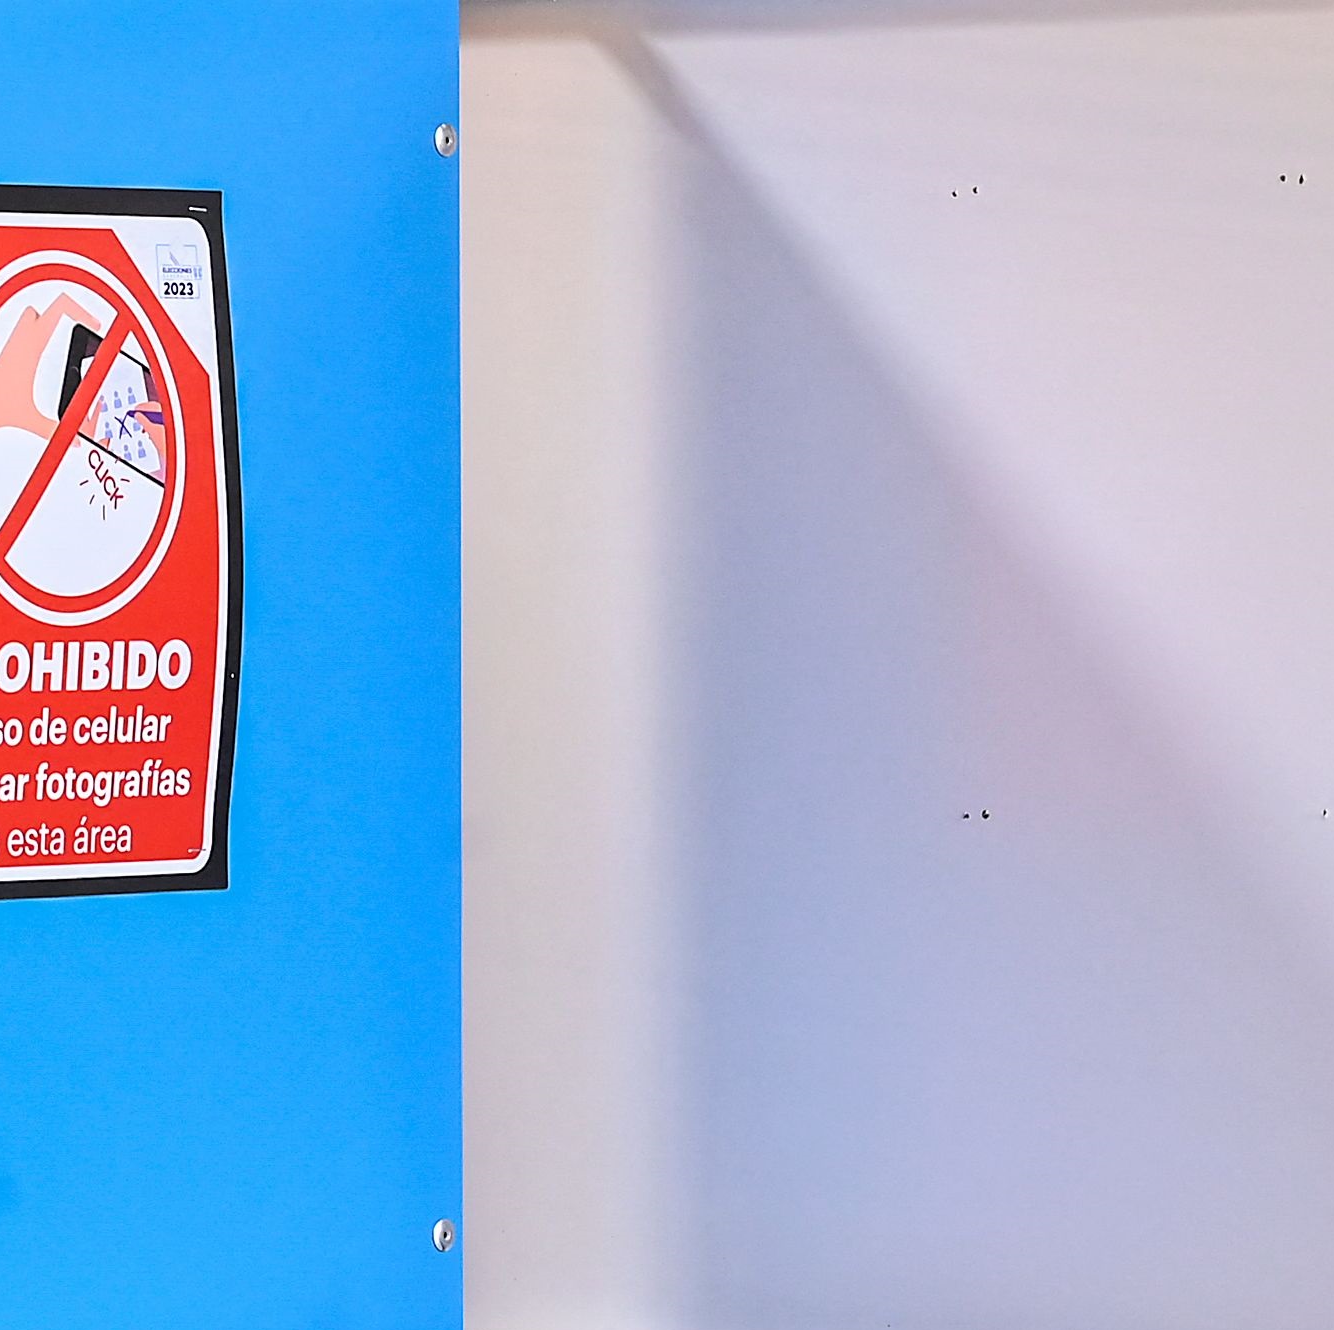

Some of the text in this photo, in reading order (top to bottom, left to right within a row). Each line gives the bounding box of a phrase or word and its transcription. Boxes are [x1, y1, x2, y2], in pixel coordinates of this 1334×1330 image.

[163, 281, 195, 296] 2023
[88, 449, 125, 510] CLICK
[29, 706, 67, 746] de
[73, 704, 173, 744] celular
[35, 758, 192, 807] fotografías
[6, 822, 65, 857] esta
[73, 815, 133, 855] área
